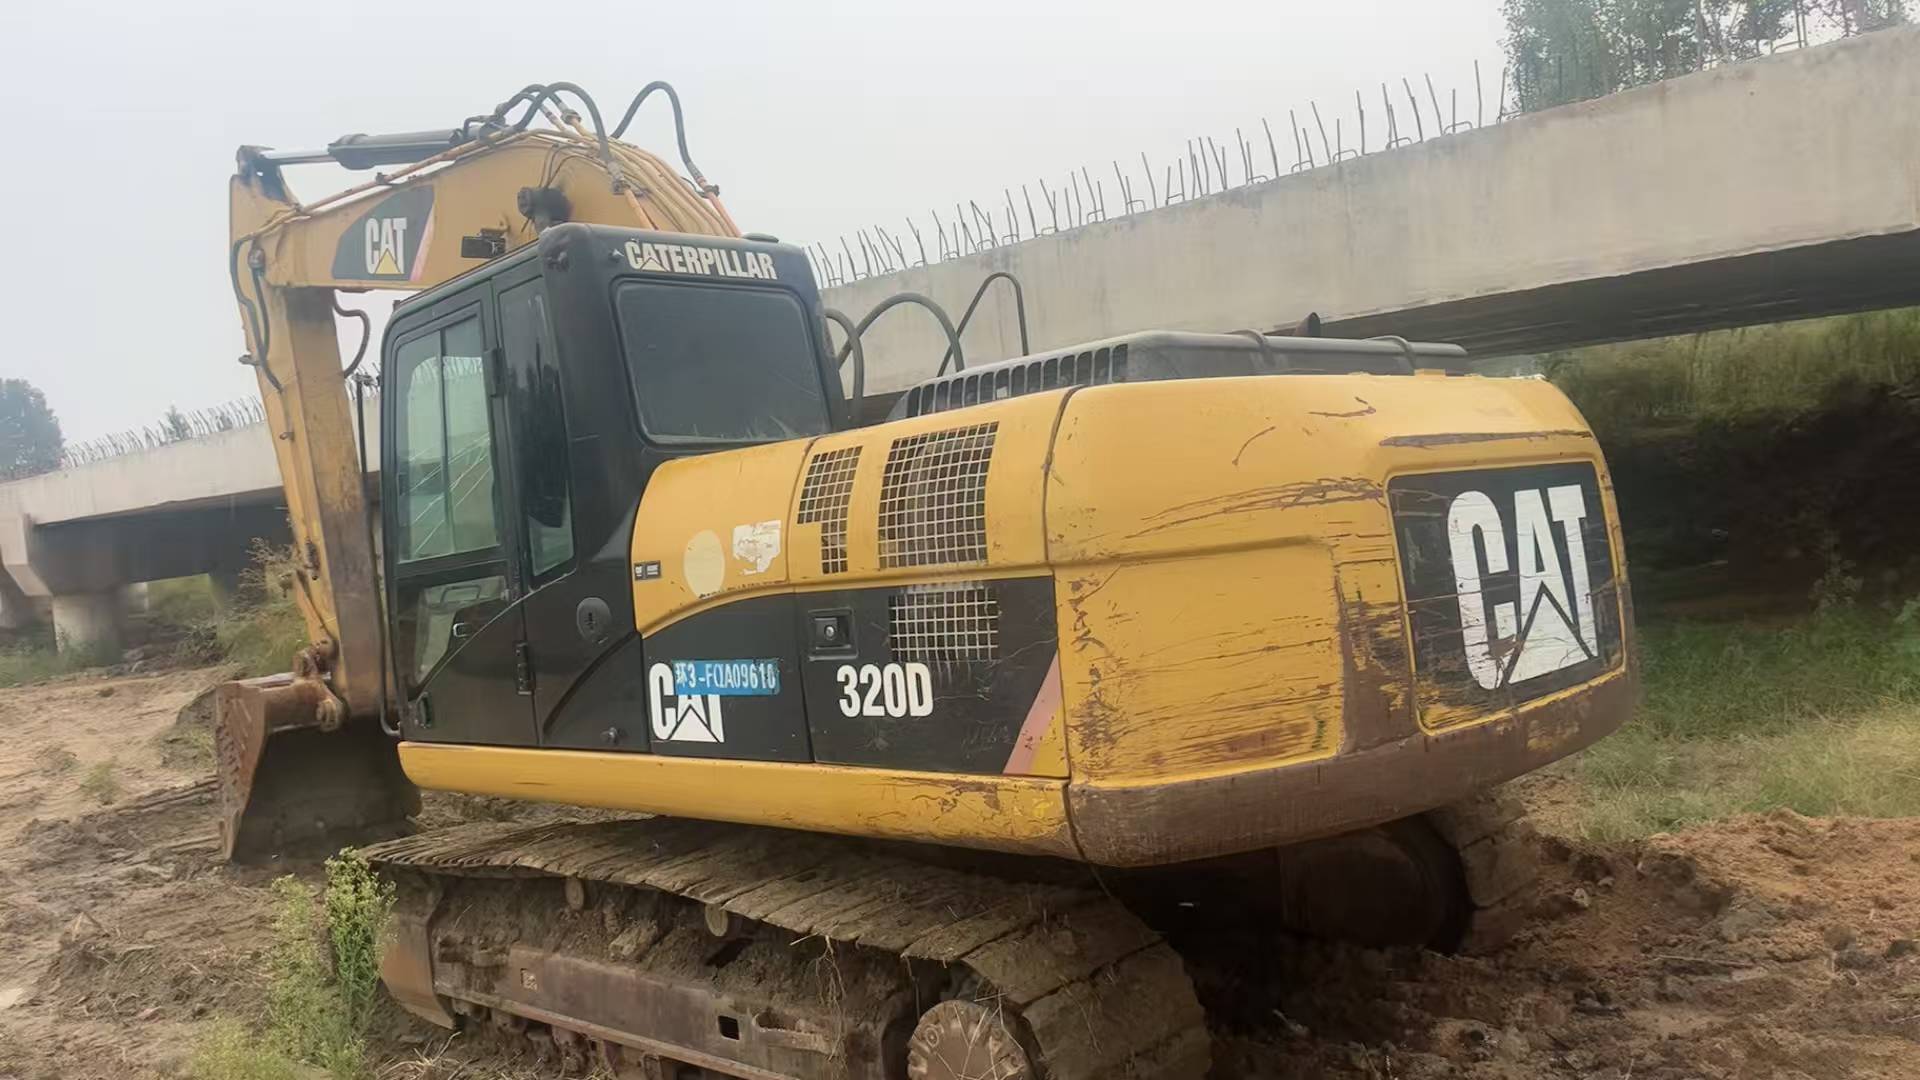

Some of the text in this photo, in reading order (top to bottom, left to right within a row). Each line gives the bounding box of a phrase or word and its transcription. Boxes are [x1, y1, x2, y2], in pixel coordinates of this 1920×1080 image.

[365, 217, 407, 274] CAT
[624, 241, 777, 280] CATERPILLAR
[1447, 485, 1598, 690] CAT
[837, 662, 934, 717] 320D
